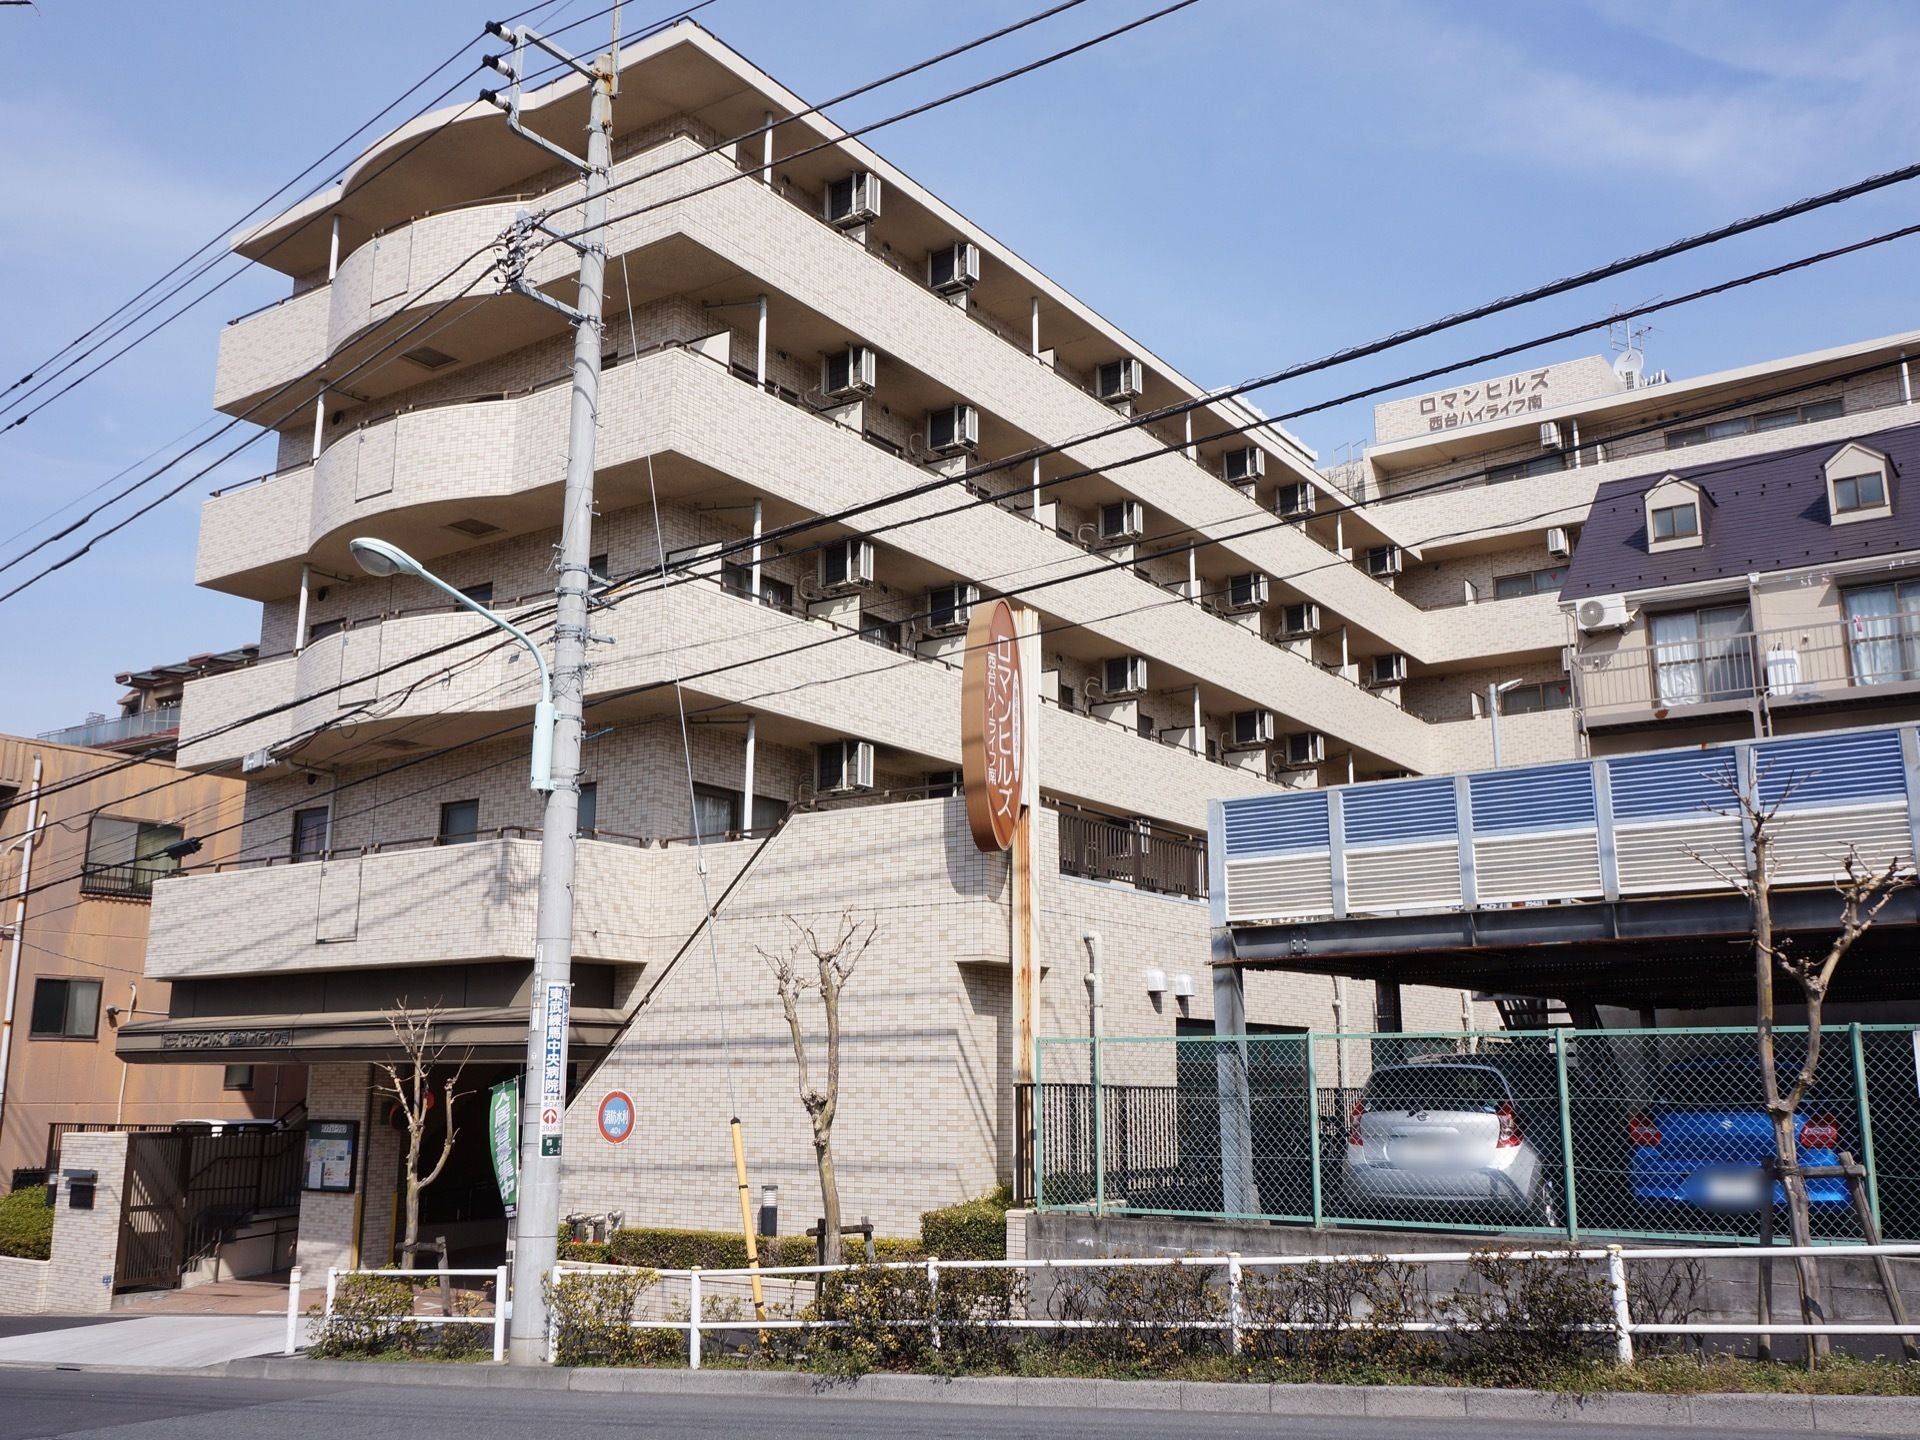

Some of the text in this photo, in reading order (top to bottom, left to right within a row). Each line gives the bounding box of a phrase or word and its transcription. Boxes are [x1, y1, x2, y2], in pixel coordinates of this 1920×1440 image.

[1420, 368, 1549, 415] ロマンヒルズ
[1429, 394, 1542, 431] 西台ハイライフ南
[987, 651, 997, 785] 西台ハイライフ南
[997, 634, 1012, 818] ロマンヒルズ
[546, 986, 563, 1093] 東武練馬中央病院
[495, 1090, 514, 1200] 入居者募集中
[603, 1109, 628, 1125] 消防水利
